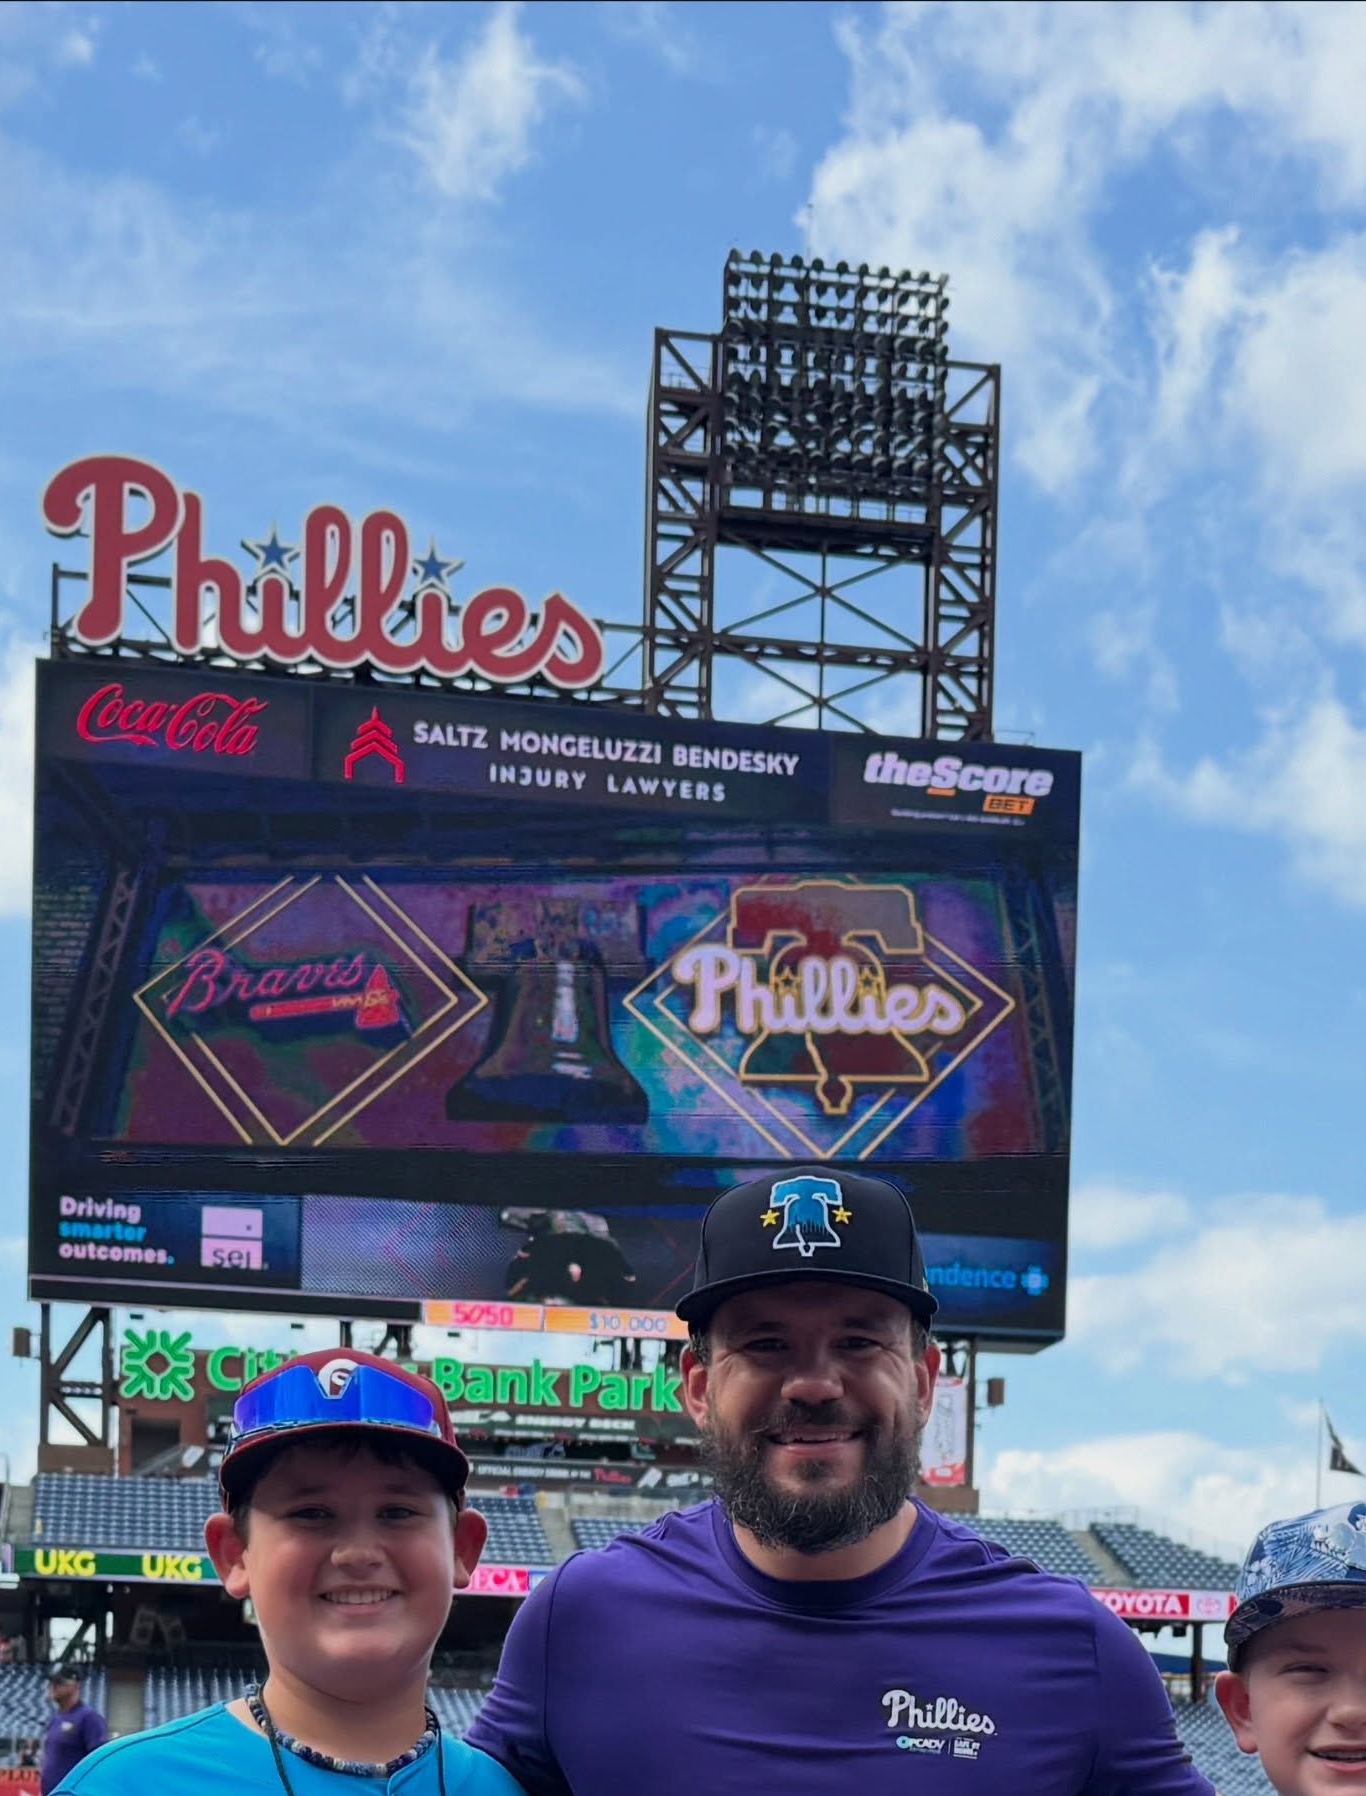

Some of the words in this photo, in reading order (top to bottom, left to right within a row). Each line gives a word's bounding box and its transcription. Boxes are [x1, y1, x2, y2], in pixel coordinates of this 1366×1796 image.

[41, 453, 608, 692] Phillies
[76, 683, 269, 756] Coca-Cola
[413, 720, 489, 751] SALTZ
[500, 729, 662, 764] MONGELUZZI
[672, 745, 800, 777] BENDESKY
[489, 763, 587, 791] INJURY
[607, 774, 727, 802] LAWYERS
[863, 751, 1055, 797] theScore
[987, 797, 1030, 813] BET
[166, 948, 367, 1018] Braves
[672, 943, 966, 1035] Phillies
[59, 1195, 142, 1224] Driving
[59, 1221, 147, 1242] smarter
[59, 1242, 175, 1265] outcomes.
[431, 1356, 561, 1407] Bank
[569, 1361, 683, 1413] Park
[35, 1549, 96, 1578] UKG
[142, 1553, 203, 1581] UKG
[882, 1689, 996, 1735] Phillies
